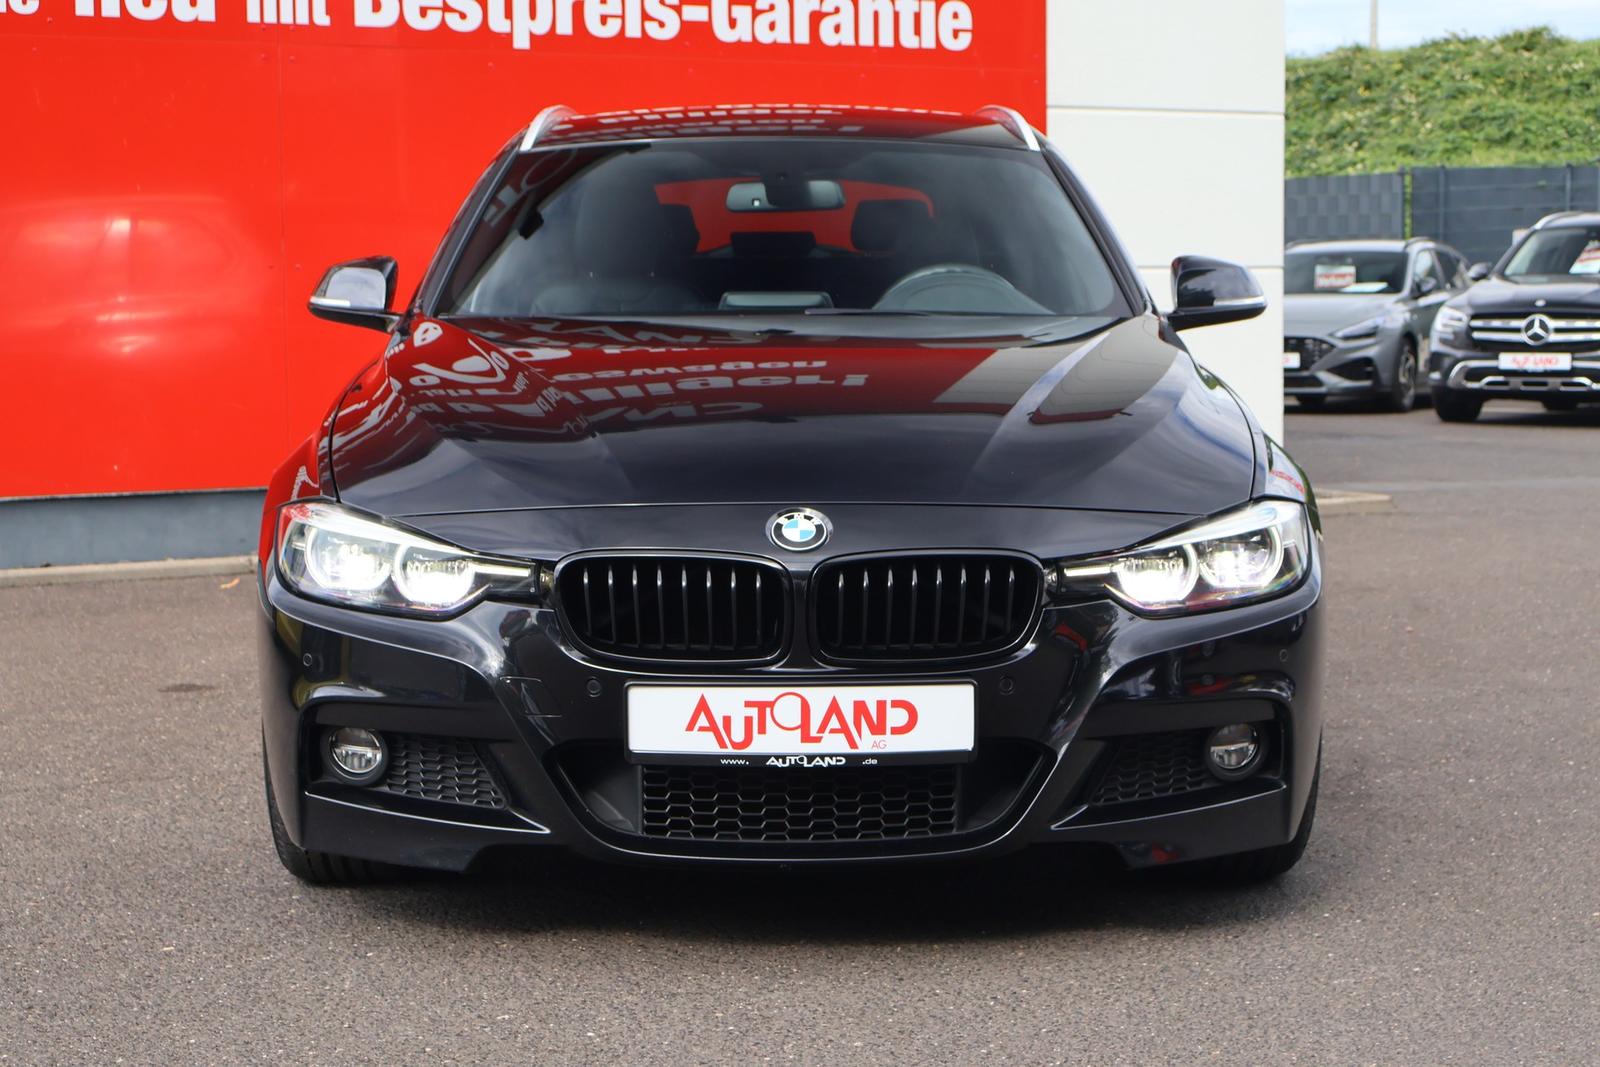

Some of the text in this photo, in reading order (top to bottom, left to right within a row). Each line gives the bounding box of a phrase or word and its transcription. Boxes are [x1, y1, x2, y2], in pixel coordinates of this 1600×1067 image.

[685, 692, 919, 751] AUTOLAND
[871, 739, 888, 750] AG
[720, 754, 879, 768] www. AUTOLAND .de
